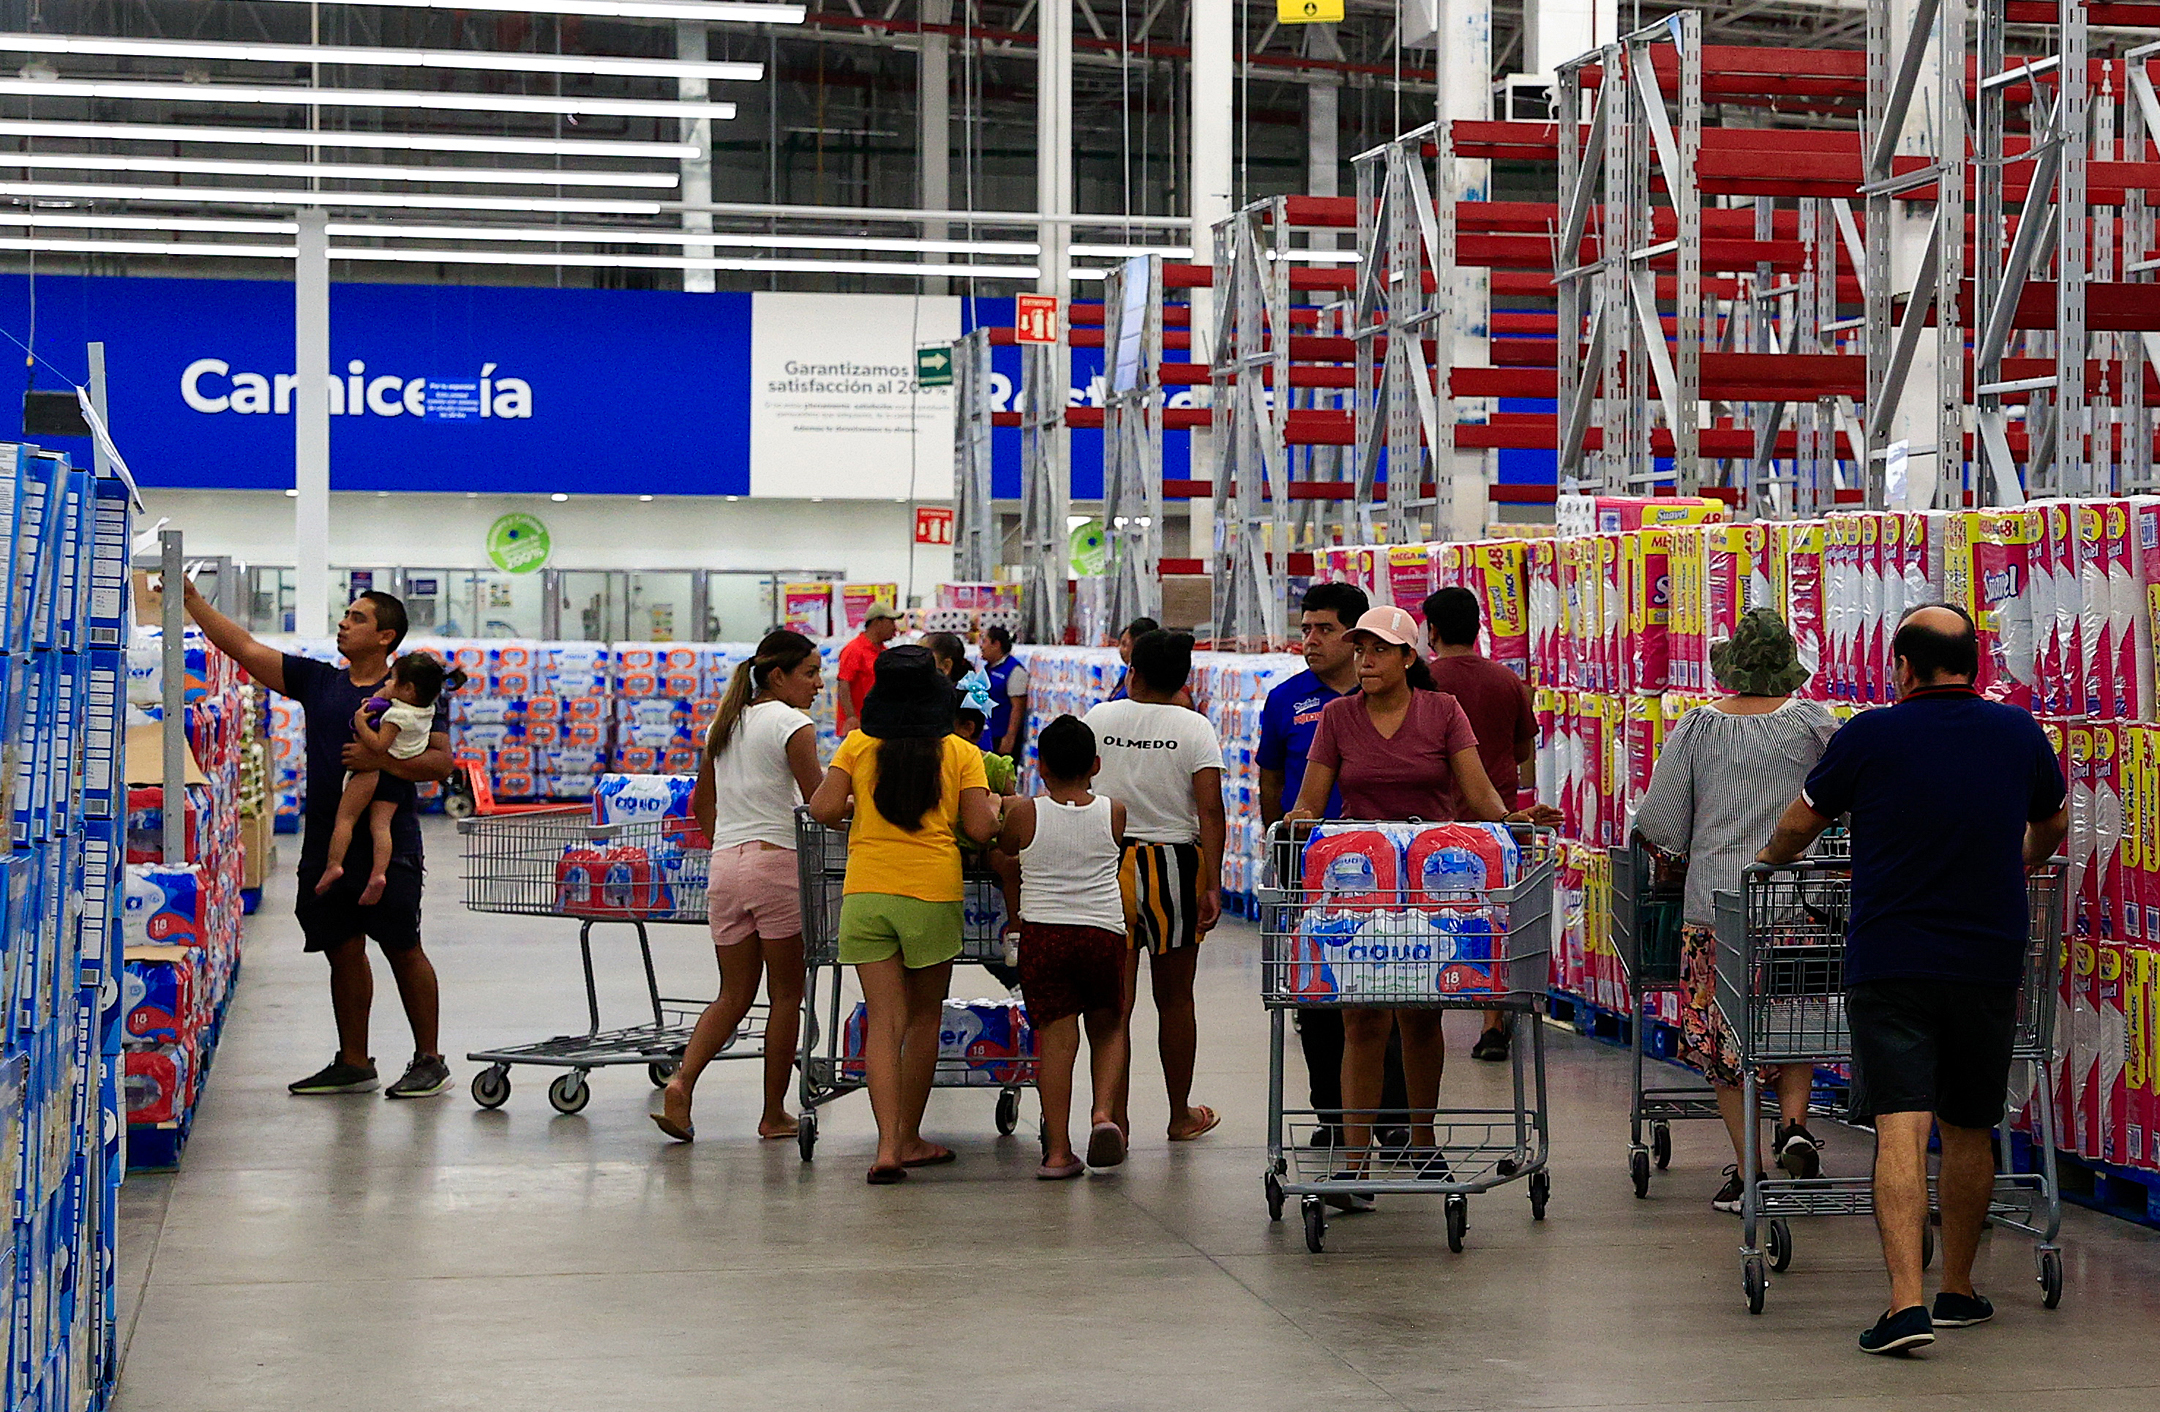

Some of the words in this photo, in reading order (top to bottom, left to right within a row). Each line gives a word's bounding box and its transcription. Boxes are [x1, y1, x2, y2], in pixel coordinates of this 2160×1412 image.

[784, 360, 909, 377] Garantizamos
[180, 358, 533, 419] Cariceía
[768, 378, 873, 394] satisfacción
[877, 379, 892, 394] al
[1657, 508, 1689, 523] Suavel
[1488, 548, 1505, 571] 48
[1504, 572, 1515, 598] PACK
[1488, 585, 1507, 621] Suavel
[1506, 598, 1521, 632] MEGA
[1103, 735, 1178, 750] OLMEDO
[153, 918, 168, 931] 18
[1348, 944, 1431, 969] aqua
[1444, 971, 1460, 984] 18
[133, 1013, 149, 1024] 18
[972, 1045, 986, 1056] 18
